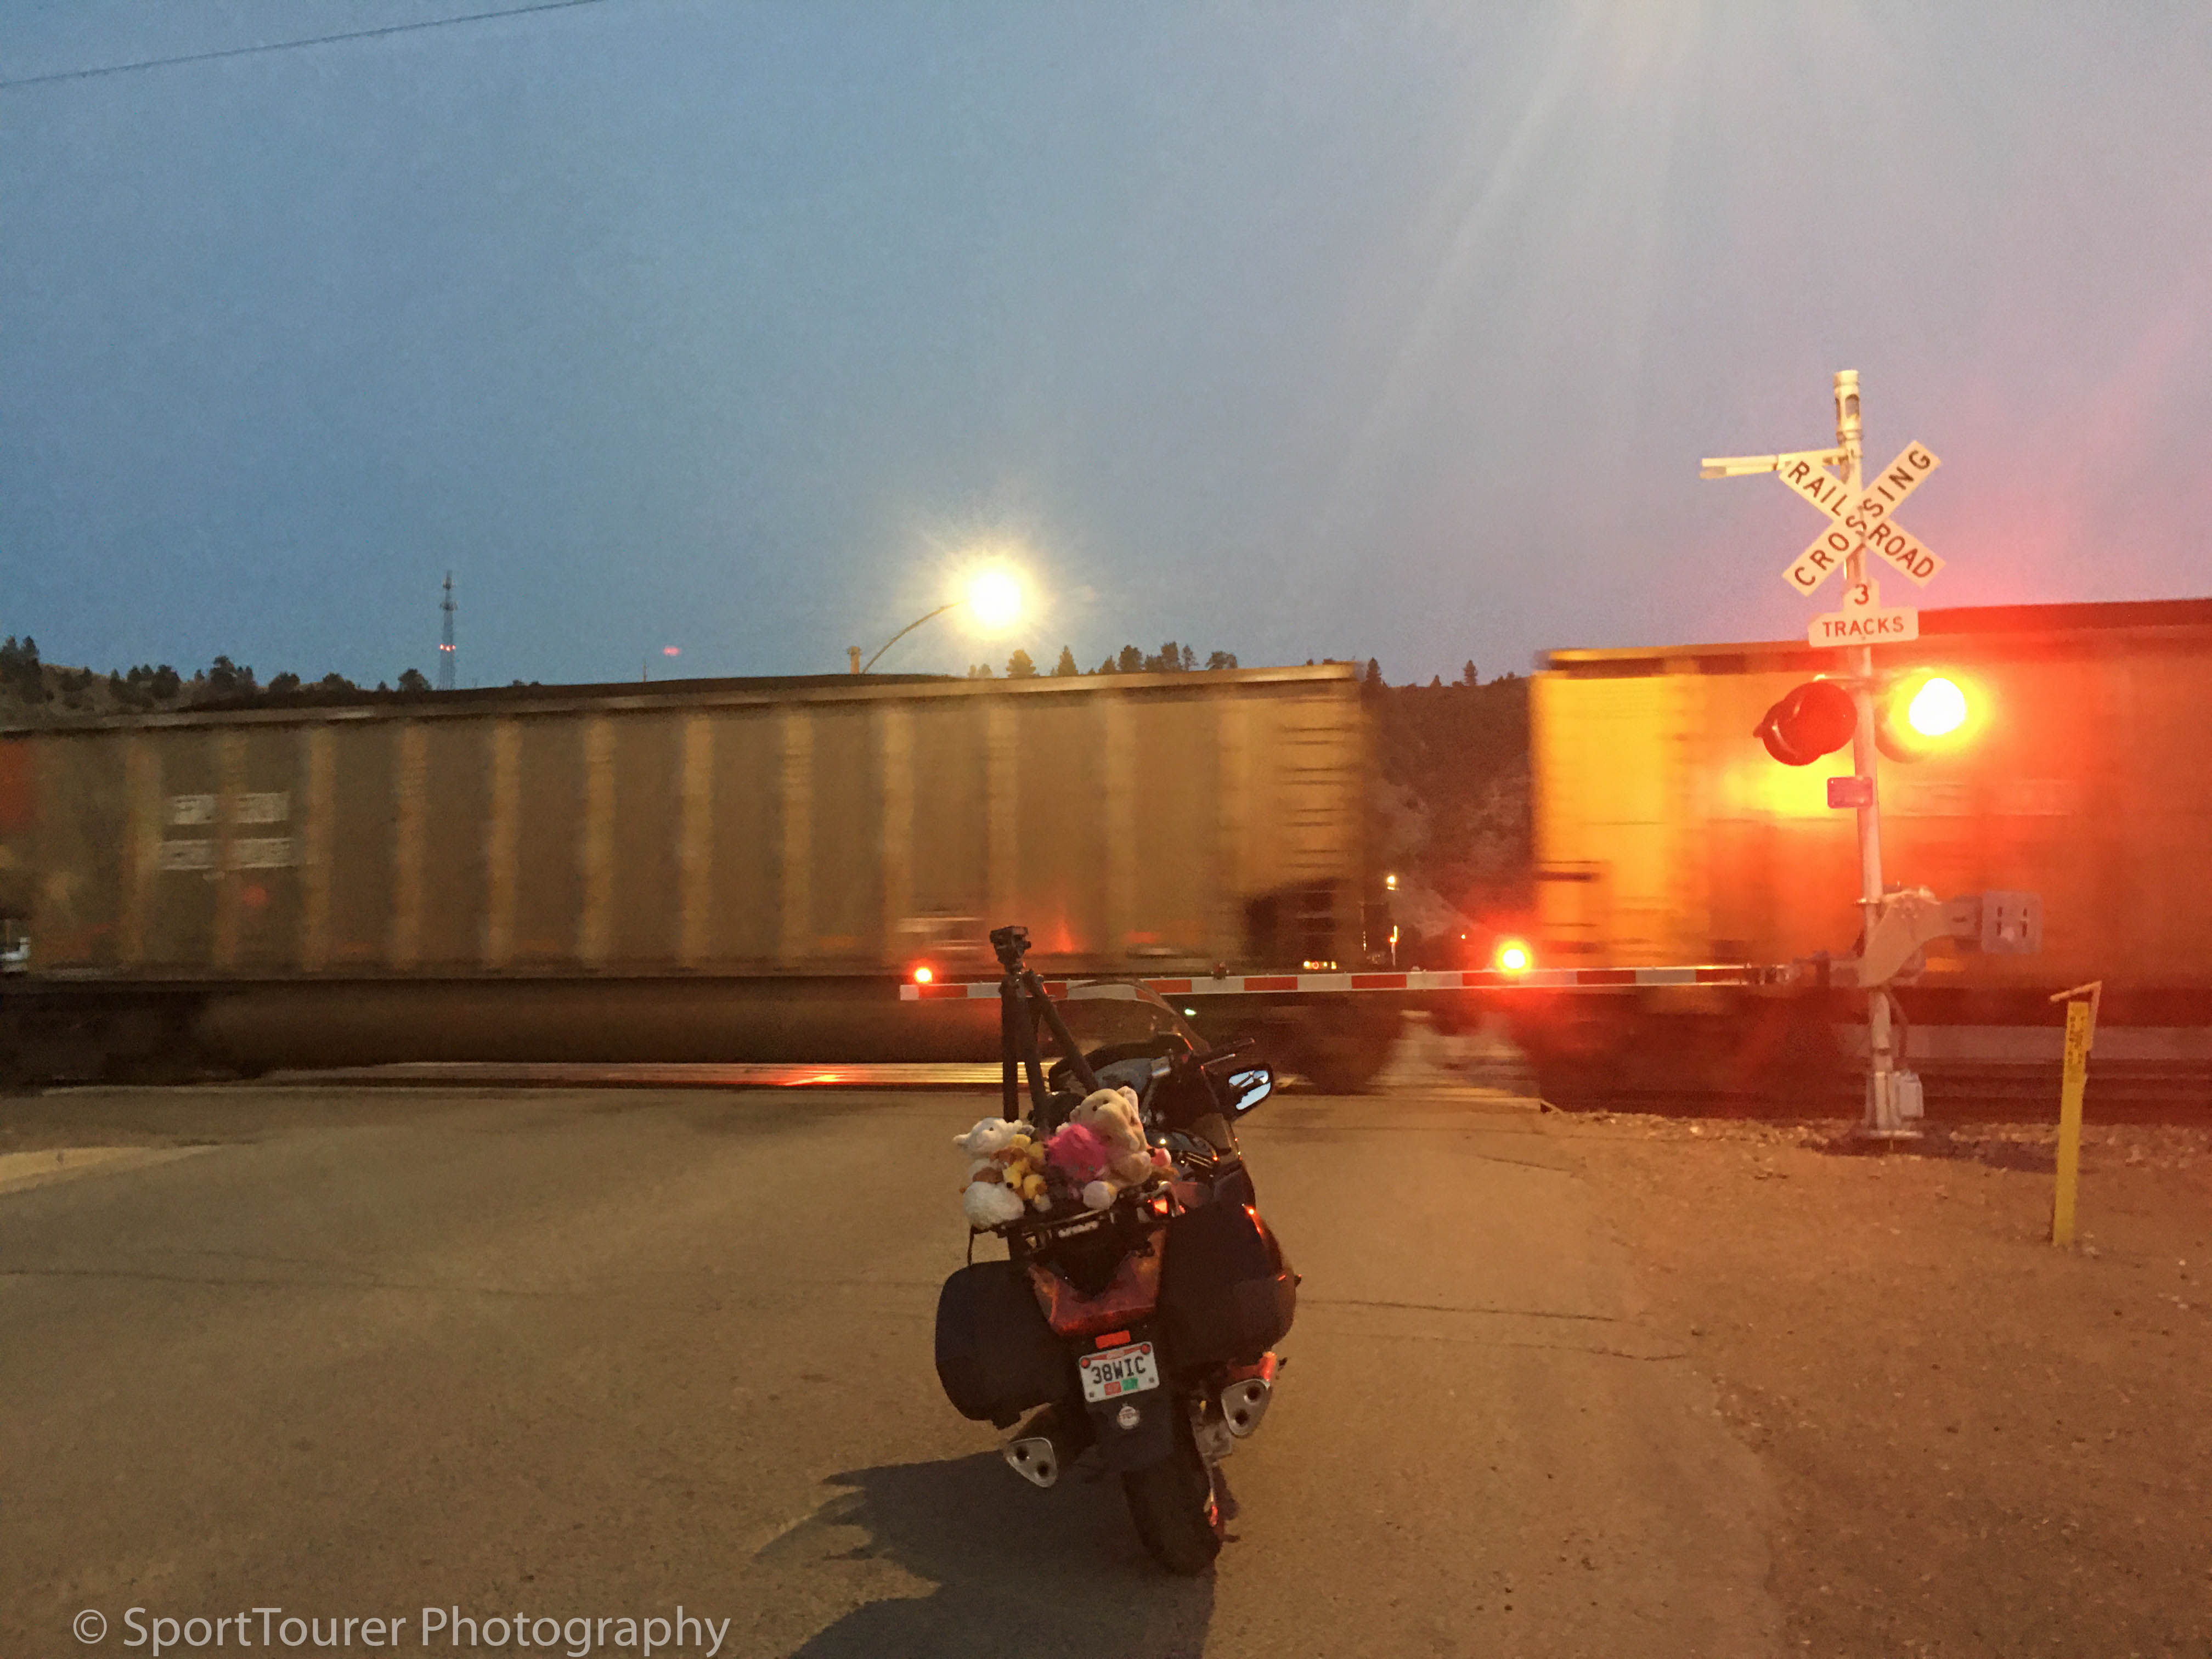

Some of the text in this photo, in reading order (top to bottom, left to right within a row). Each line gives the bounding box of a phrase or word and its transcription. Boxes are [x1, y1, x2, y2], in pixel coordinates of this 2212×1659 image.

[1794, 449, 1931, 586] CROSSING
[1854, 584, 1869, 605] 3
[1822, 616, 1904, 637] TRACKS
[1091, 1356, 1146, 1384] 38WIC
